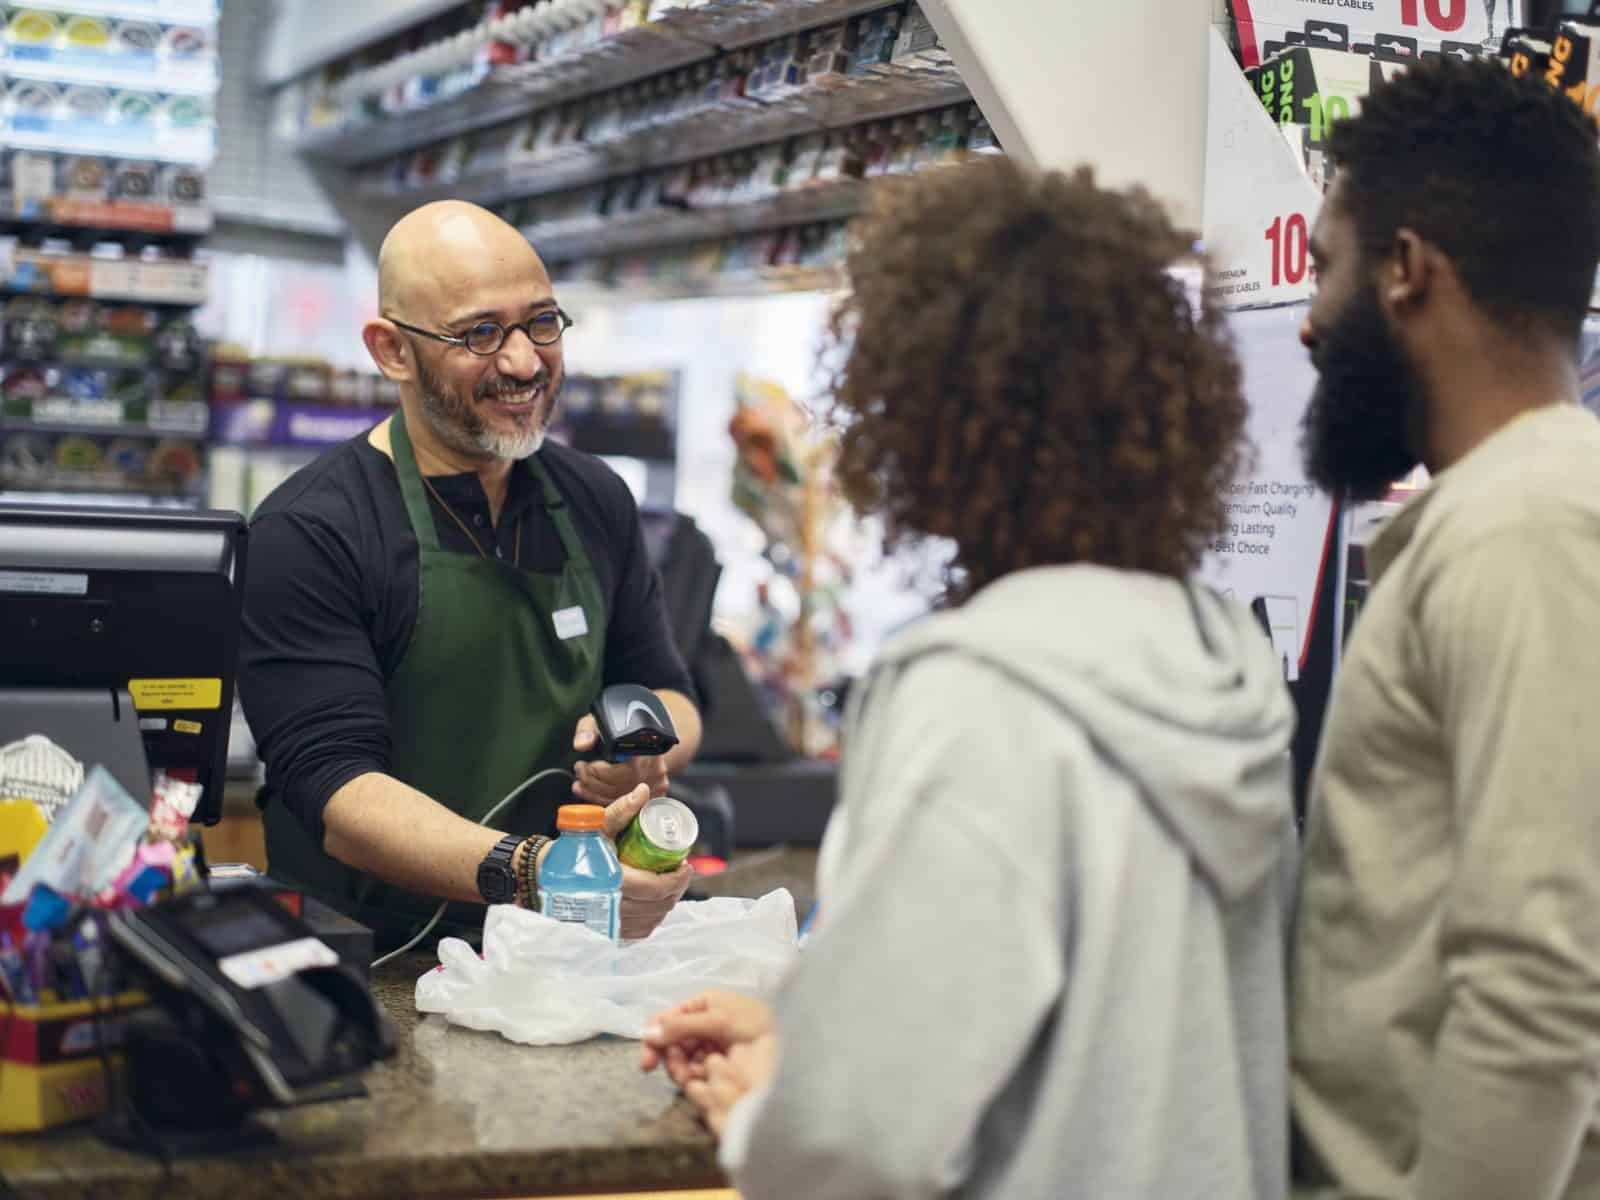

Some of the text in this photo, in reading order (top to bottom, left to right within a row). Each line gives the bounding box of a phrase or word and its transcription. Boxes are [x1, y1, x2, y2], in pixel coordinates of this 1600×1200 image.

[1338, 0, 1374, 10] CABLES
[1280, 59, 1293, 125] ONG
[1265, 213, 1306, 286] 10
[1236, 281, 1260, 293] CABLES
[1219, 501, 1296, 518] remium Quality
[1241, 523, 1275, 538] Lasting
[1216, 541, 1269, 554] Best Choice
